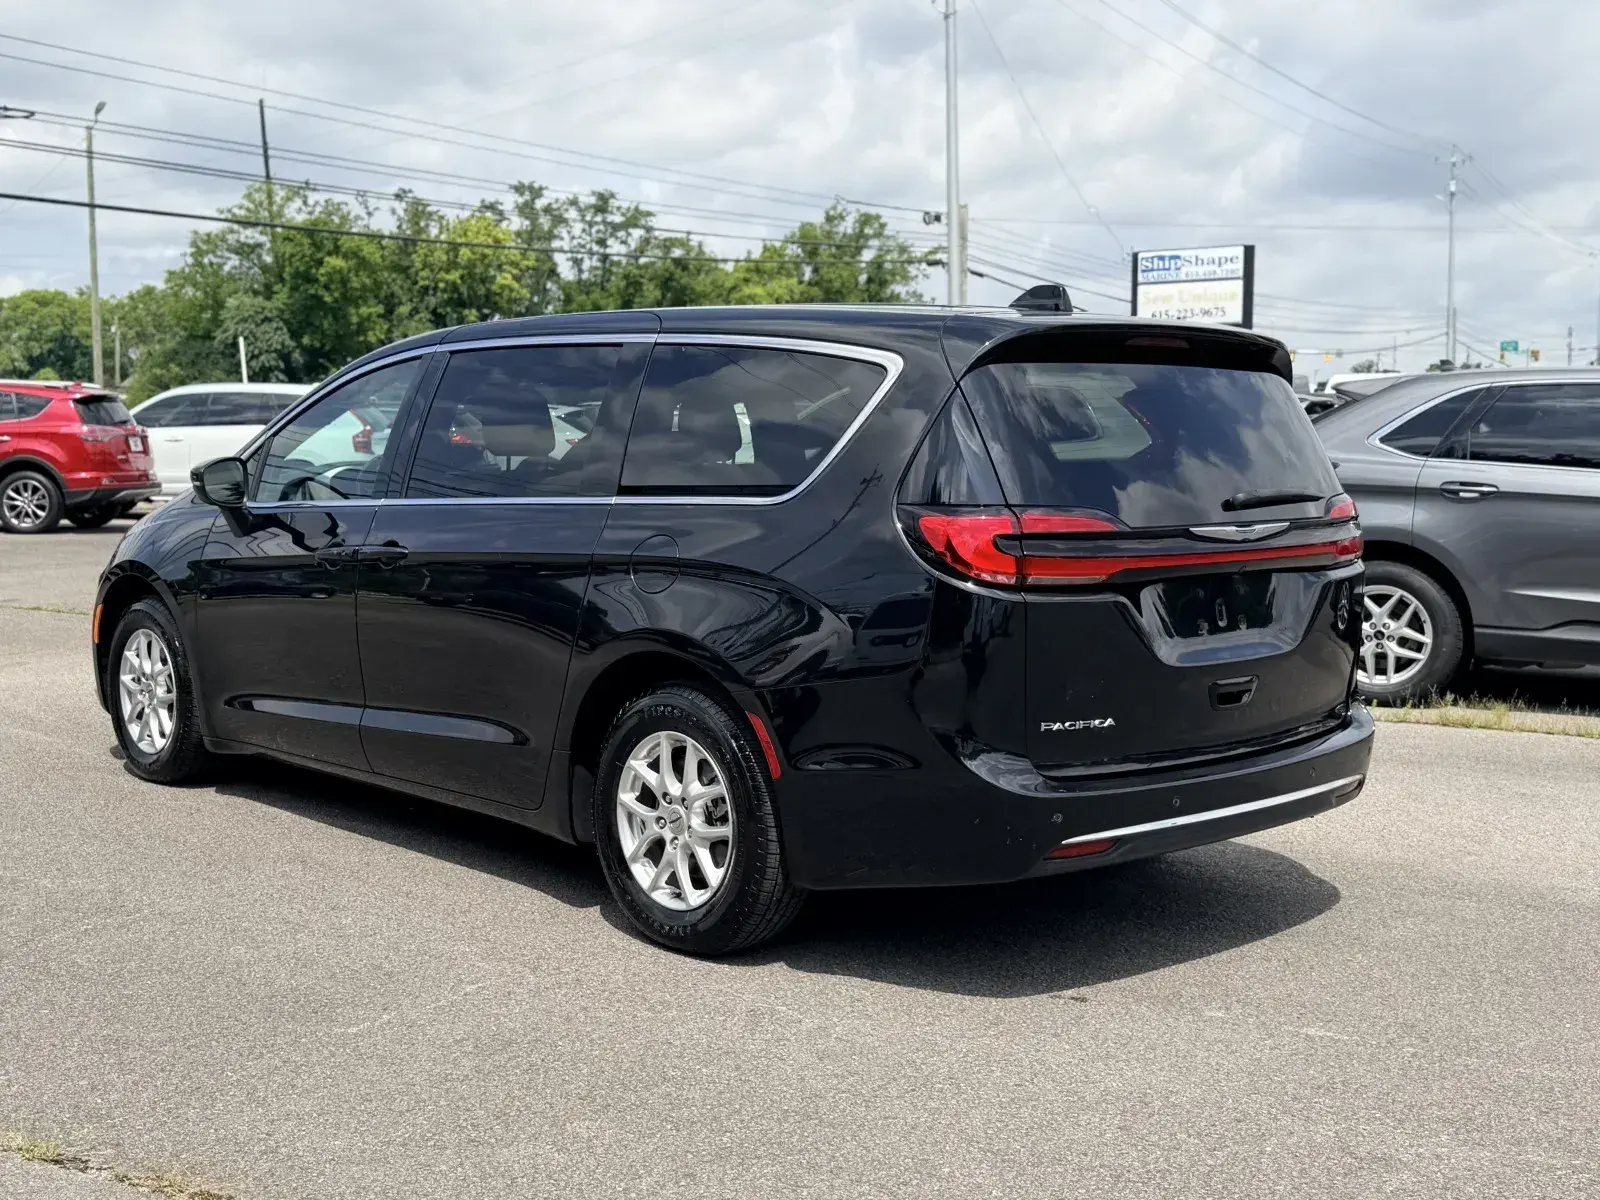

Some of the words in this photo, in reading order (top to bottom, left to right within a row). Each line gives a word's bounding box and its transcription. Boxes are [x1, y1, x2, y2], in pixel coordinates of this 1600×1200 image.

[1141, 271, 1180, 281] MARINE
[1151, 306, 1226, 320] 615-223-9675
[1040, 717, 1116, 732] PACIFICA
